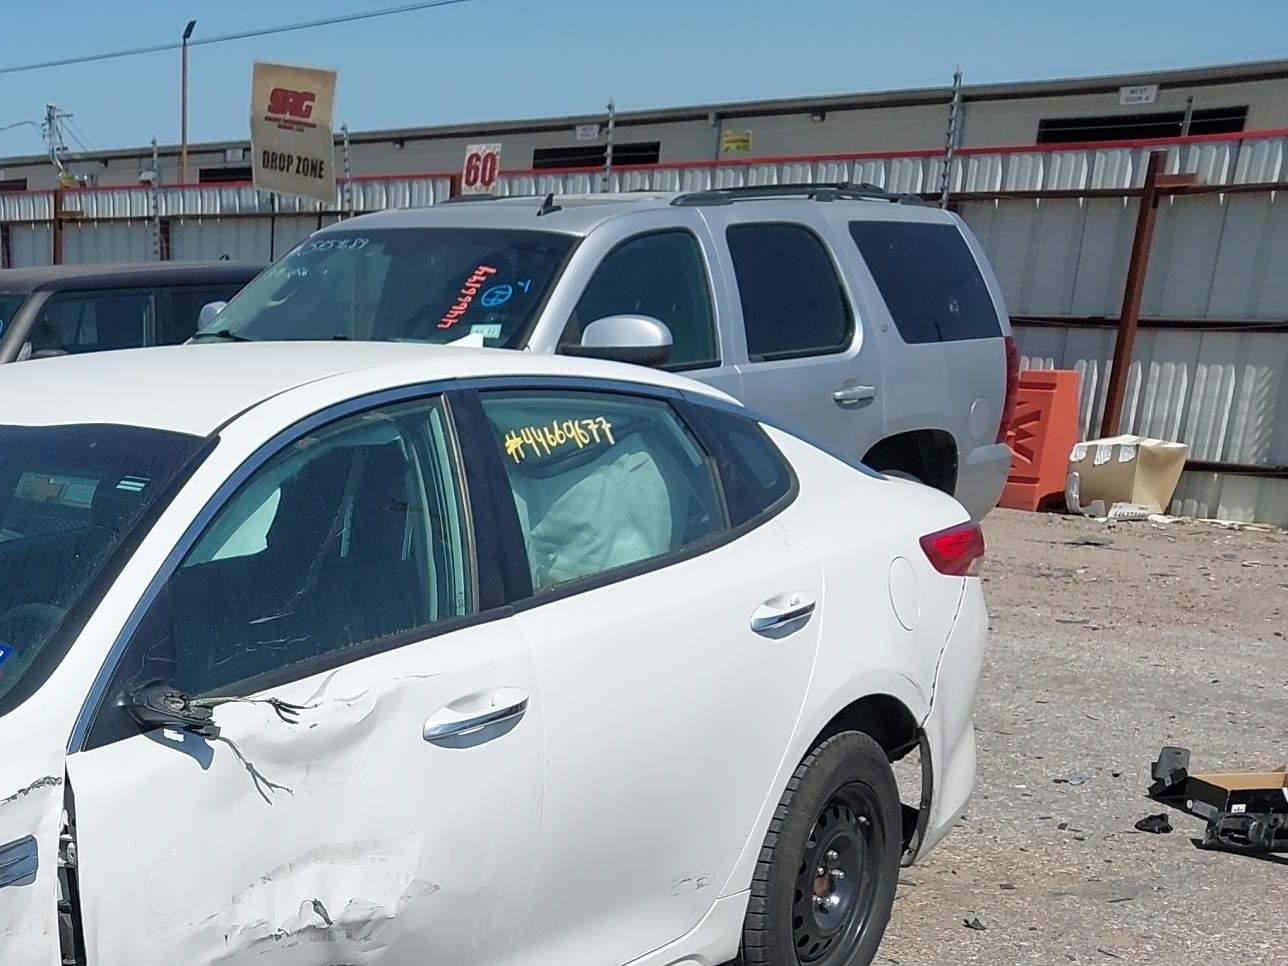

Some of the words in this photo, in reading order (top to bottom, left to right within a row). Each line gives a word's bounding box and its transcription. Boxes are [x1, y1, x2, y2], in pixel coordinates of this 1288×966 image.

[267, 88, 316, 119] SRG
[262, 150, 294, 173] DROP
[295, 155, 326, 179] ZONE
[464, 152, 497, 187] 60
[504, 415, 616, 464] #44669677
